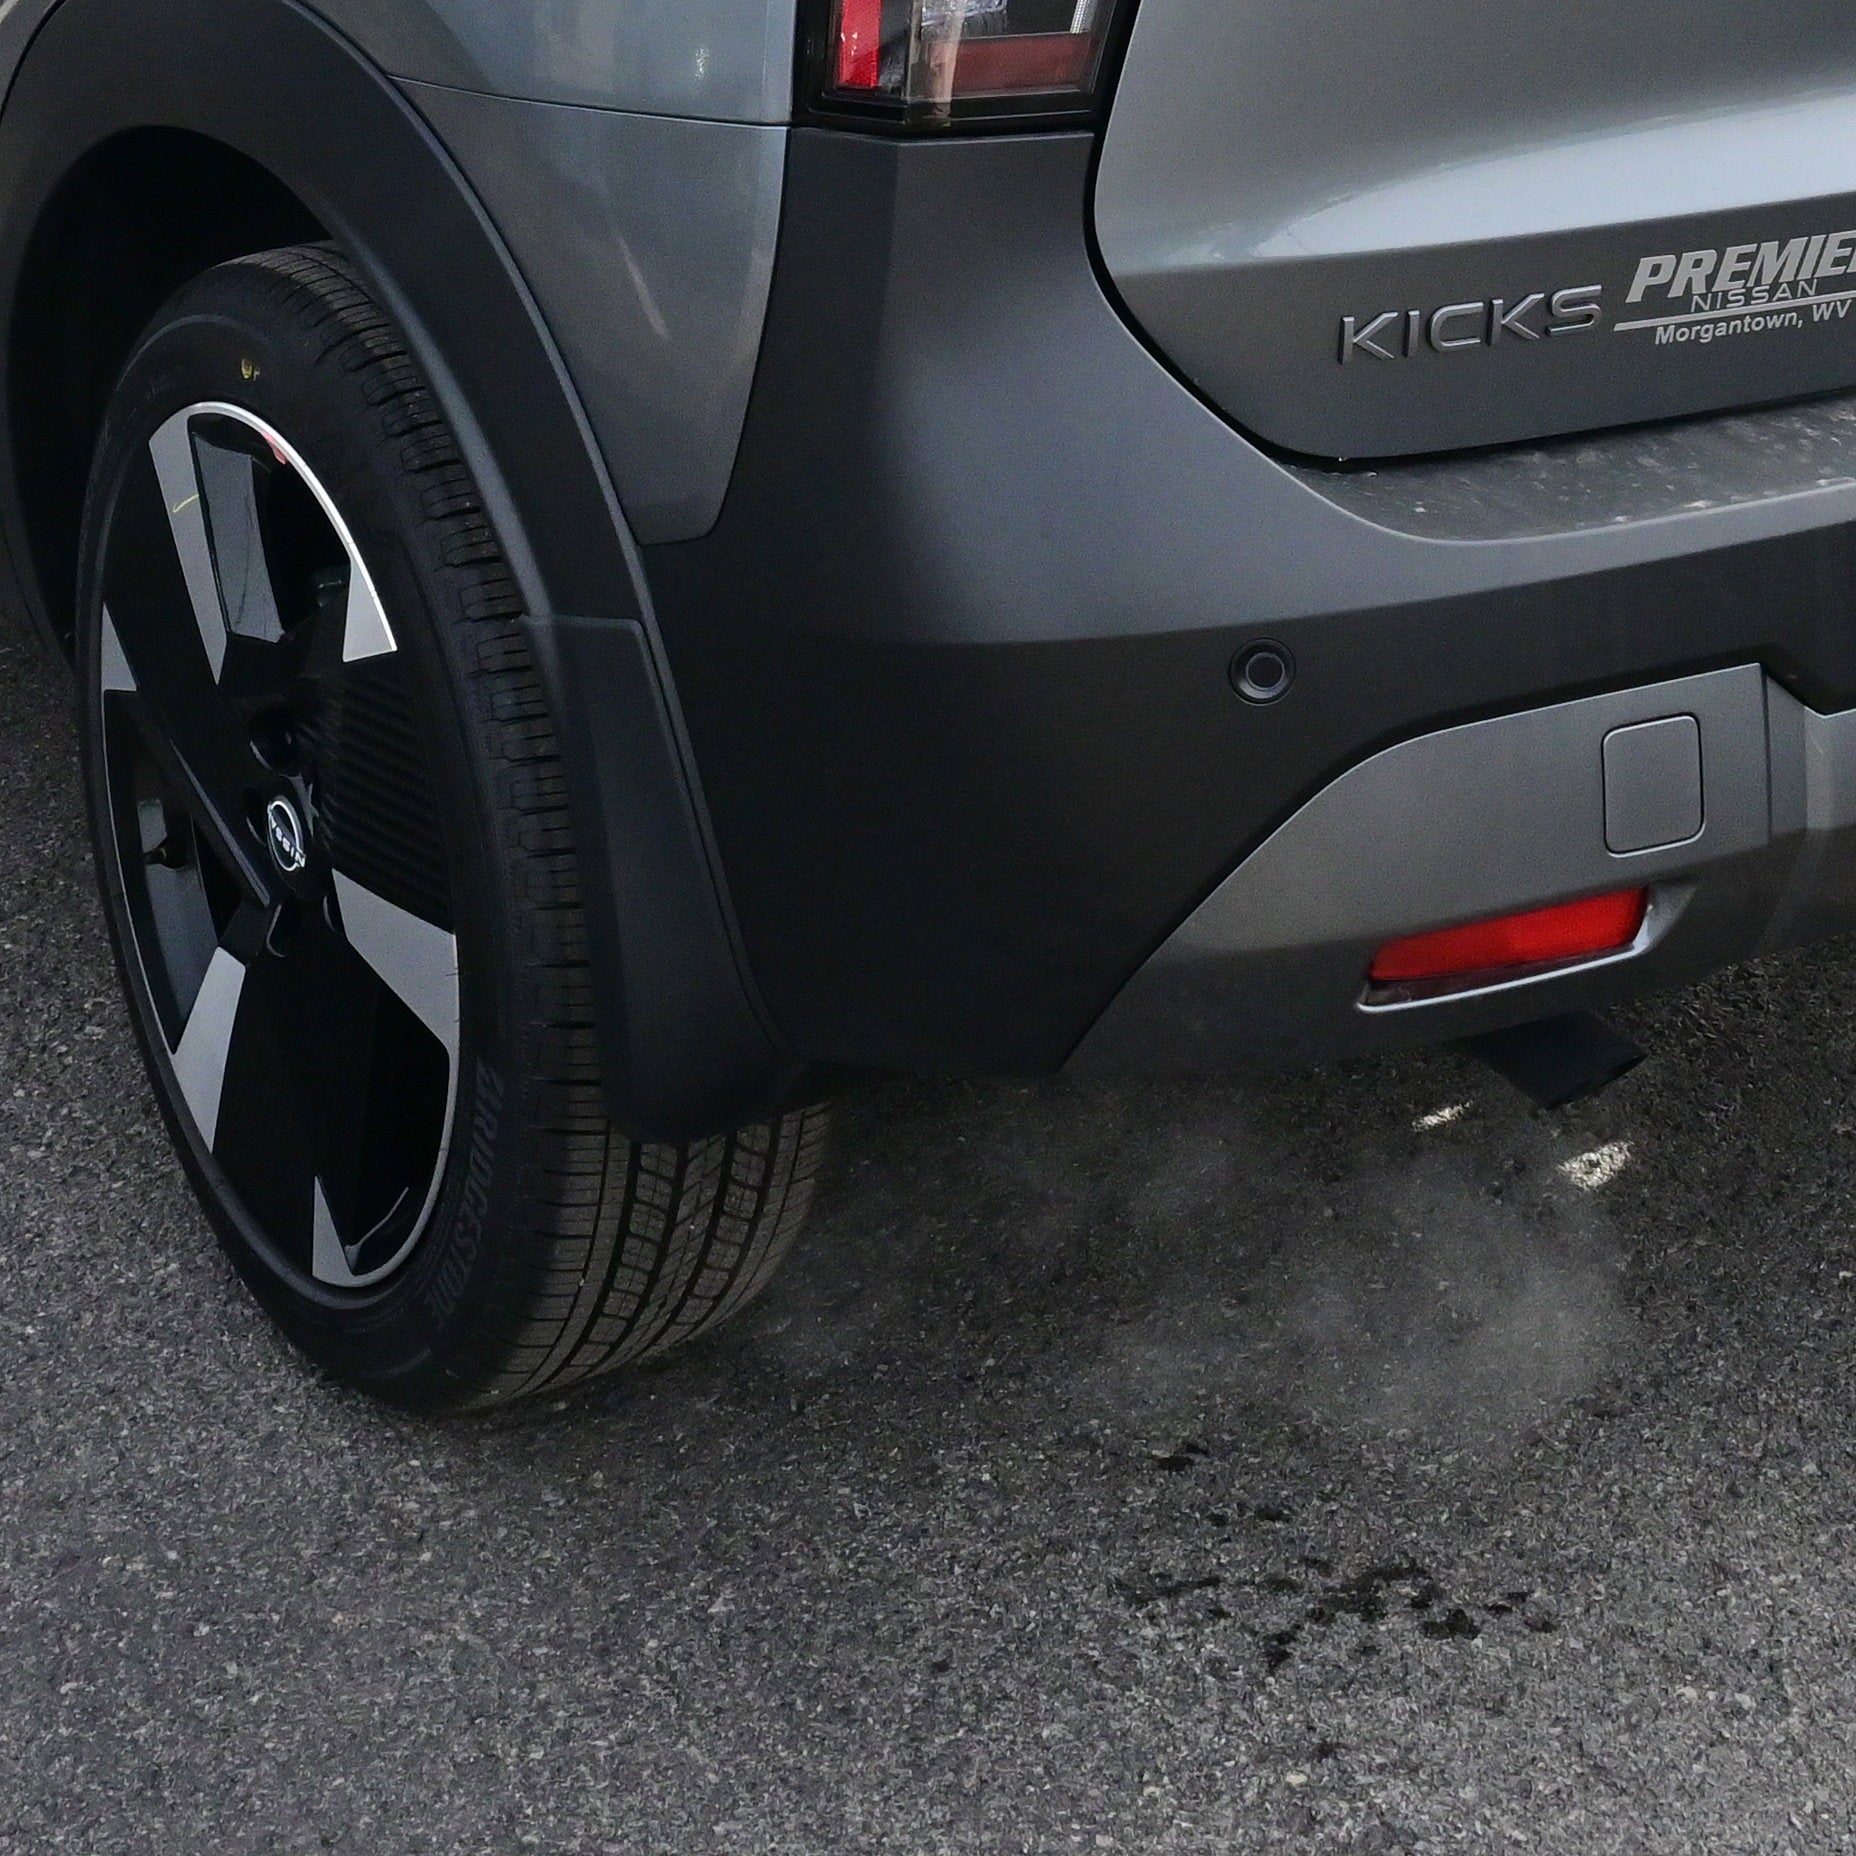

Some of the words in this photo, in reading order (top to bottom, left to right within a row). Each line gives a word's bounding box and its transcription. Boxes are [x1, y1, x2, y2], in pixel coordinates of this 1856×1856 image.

[1690, 277, 1818, 313] NISSAN
[1338, 284, 1603, 365] KICKS
[1654, 311, 1803, 346] Morgantown,
[1811, 299, 1853, 321] WV
